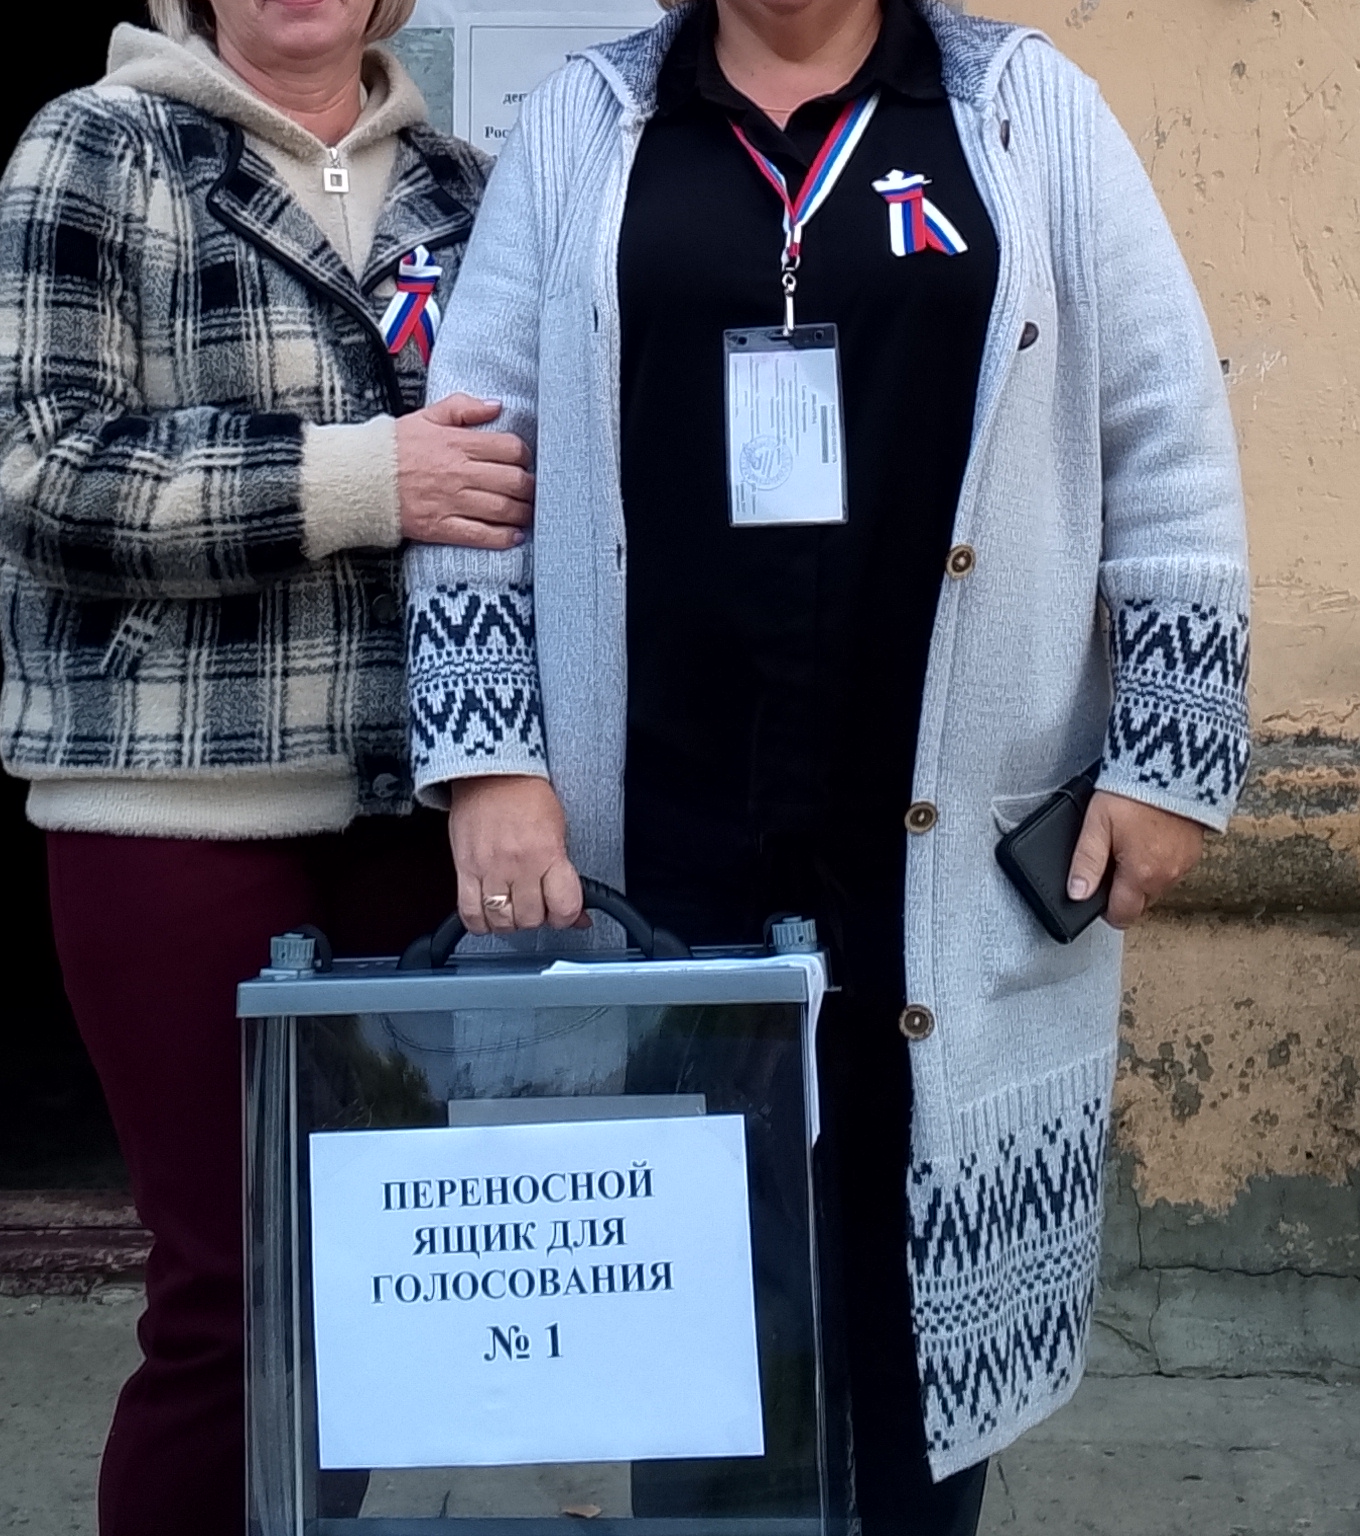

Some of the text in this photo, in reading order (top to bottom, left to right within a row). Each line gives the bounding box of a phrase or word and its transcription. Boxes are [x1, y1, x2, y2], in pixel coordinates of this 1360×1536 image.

[381, 1160, 655, 1211] ПЕРЕНОСНОЙ
[411, 1216, 627, 1258] ЯЩИК ДЛЯ
[370, 1261, 674, 1304] ГОЛОСОВАНИЯ
[483, 1322, 564, 1362] № 1
